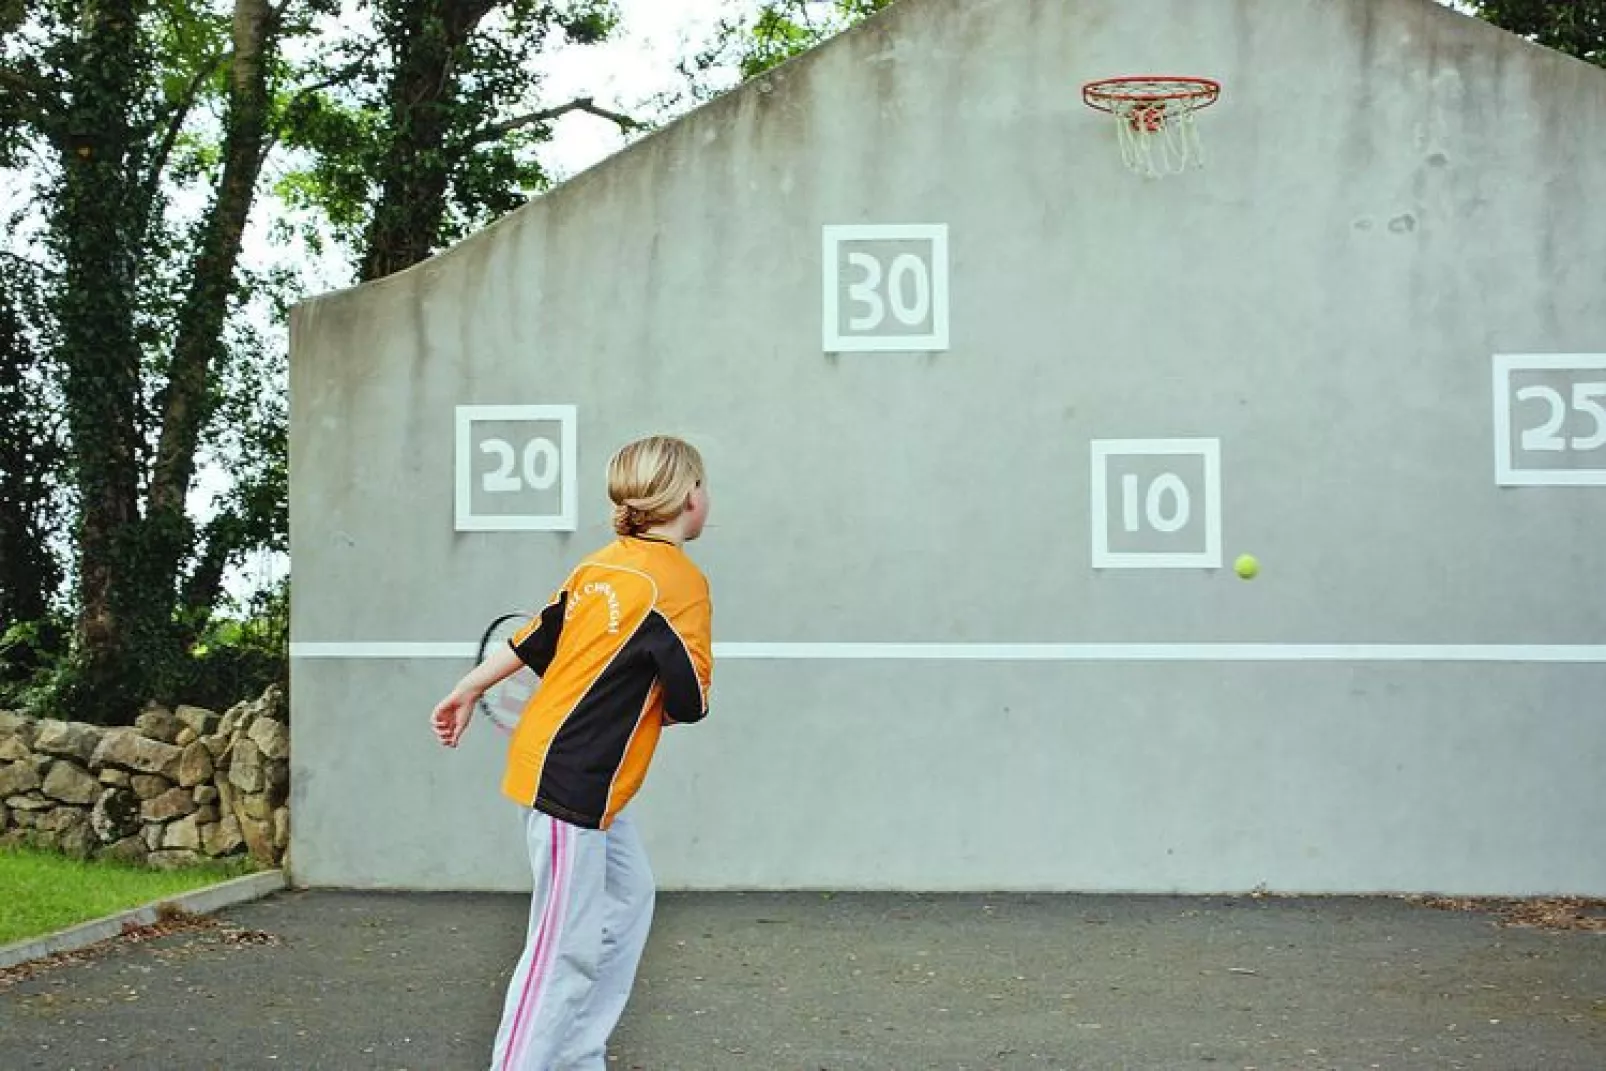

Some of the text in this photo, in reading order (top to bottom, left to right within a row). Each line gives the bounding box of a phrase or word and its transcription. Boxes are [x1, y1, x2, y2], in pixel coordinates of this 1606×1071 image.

[848, 252, 930, 331] 30
[1515, 382, 1606, 451] 25
[479, 437, 560, 491] 20
[1122, 472, 1191, 532] 10
